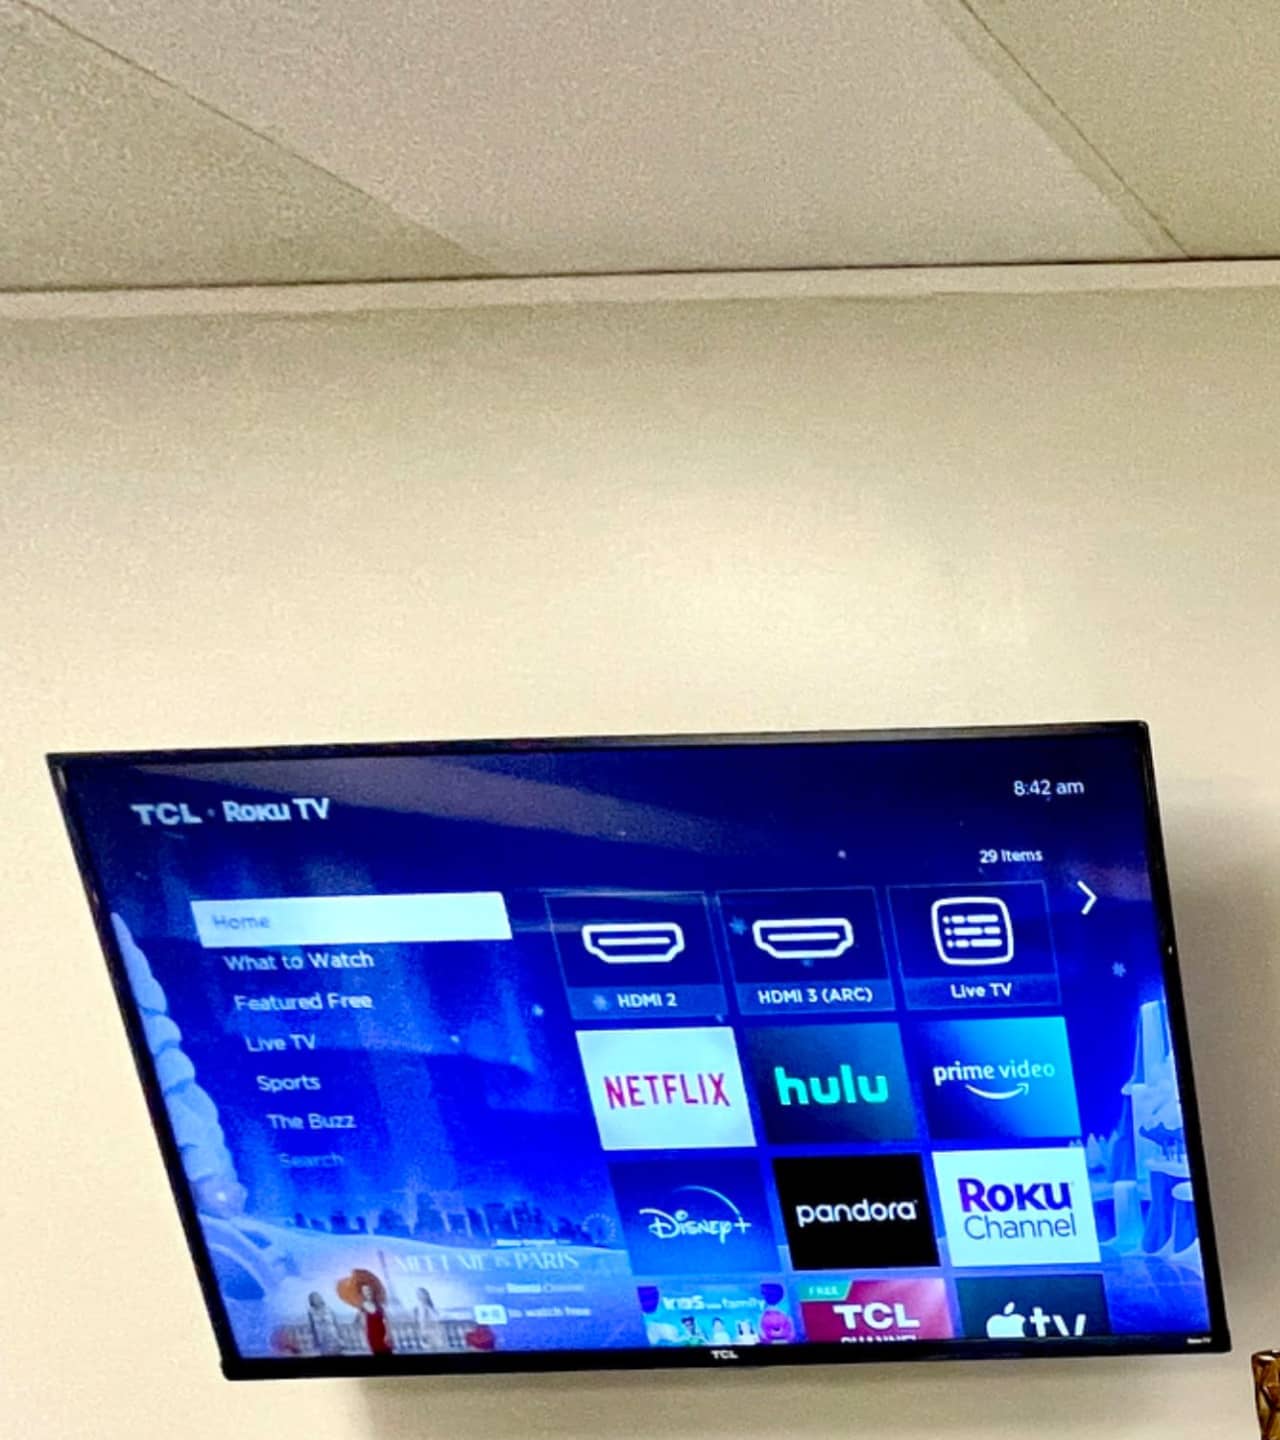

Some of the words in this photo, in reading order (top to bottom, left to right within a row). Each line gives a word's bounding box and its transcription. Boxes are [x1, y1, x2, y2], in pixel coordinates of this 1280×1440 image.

[1013, 779, 1052, 797] 8:42
[1056, 781, 1085, 796] am
[131, 803, 202, 826] TCL
[224, 801, 292, 823] Roku
[293, 798, 330, 820] TV
[979, 849, 998, 864] 29
[212, 912, 271, 930] Home
[223, 953, 277, 972] What
[280, 954, 303, 970] to
[308, 949, 375, 969] Watch
[617, 993, 662, 1008] HDMI
[666, 993, 678, 1007] 2
[758, 988, 803, 1004] HDMI
[807, 988, 818, 1003] 3
[821, 986, 873, 1005] (ARC)
[951, 984, 985, 999] Live
[988, 982, 1012, 998] TV
[233, 993, 322, 1012] Featured
[328, 992, 374, 1010] Free
[246, 1034, 287, 1052] Live
[292, 1033, 316, 1051] TV
[933, 1062, 996, 1086] prime
[999, 1058, 1056, 1080] video
[256, 1074, 321, 1094] Sports
[603, 1072, 731, 1110] NETFLIX
[774, 1065, 889, 1106] hulu
[267, 1112, 303, 1130] The
[309, 1111, 357, 1130] Buzz
[279, 1150, 344, 1168] Search
[958, 1177, 1072, 1213] Roku
[796, 1199, 916, 1228] pandora
[639, 1207, 751, 1243] Disney+
[963, 1213, 1077, 1240] Channel
[833, 1302, 921, 1331] TCL
[1029, 1307, 1087, 1337] tv
[711, 1349, 738, 1359] TCL
